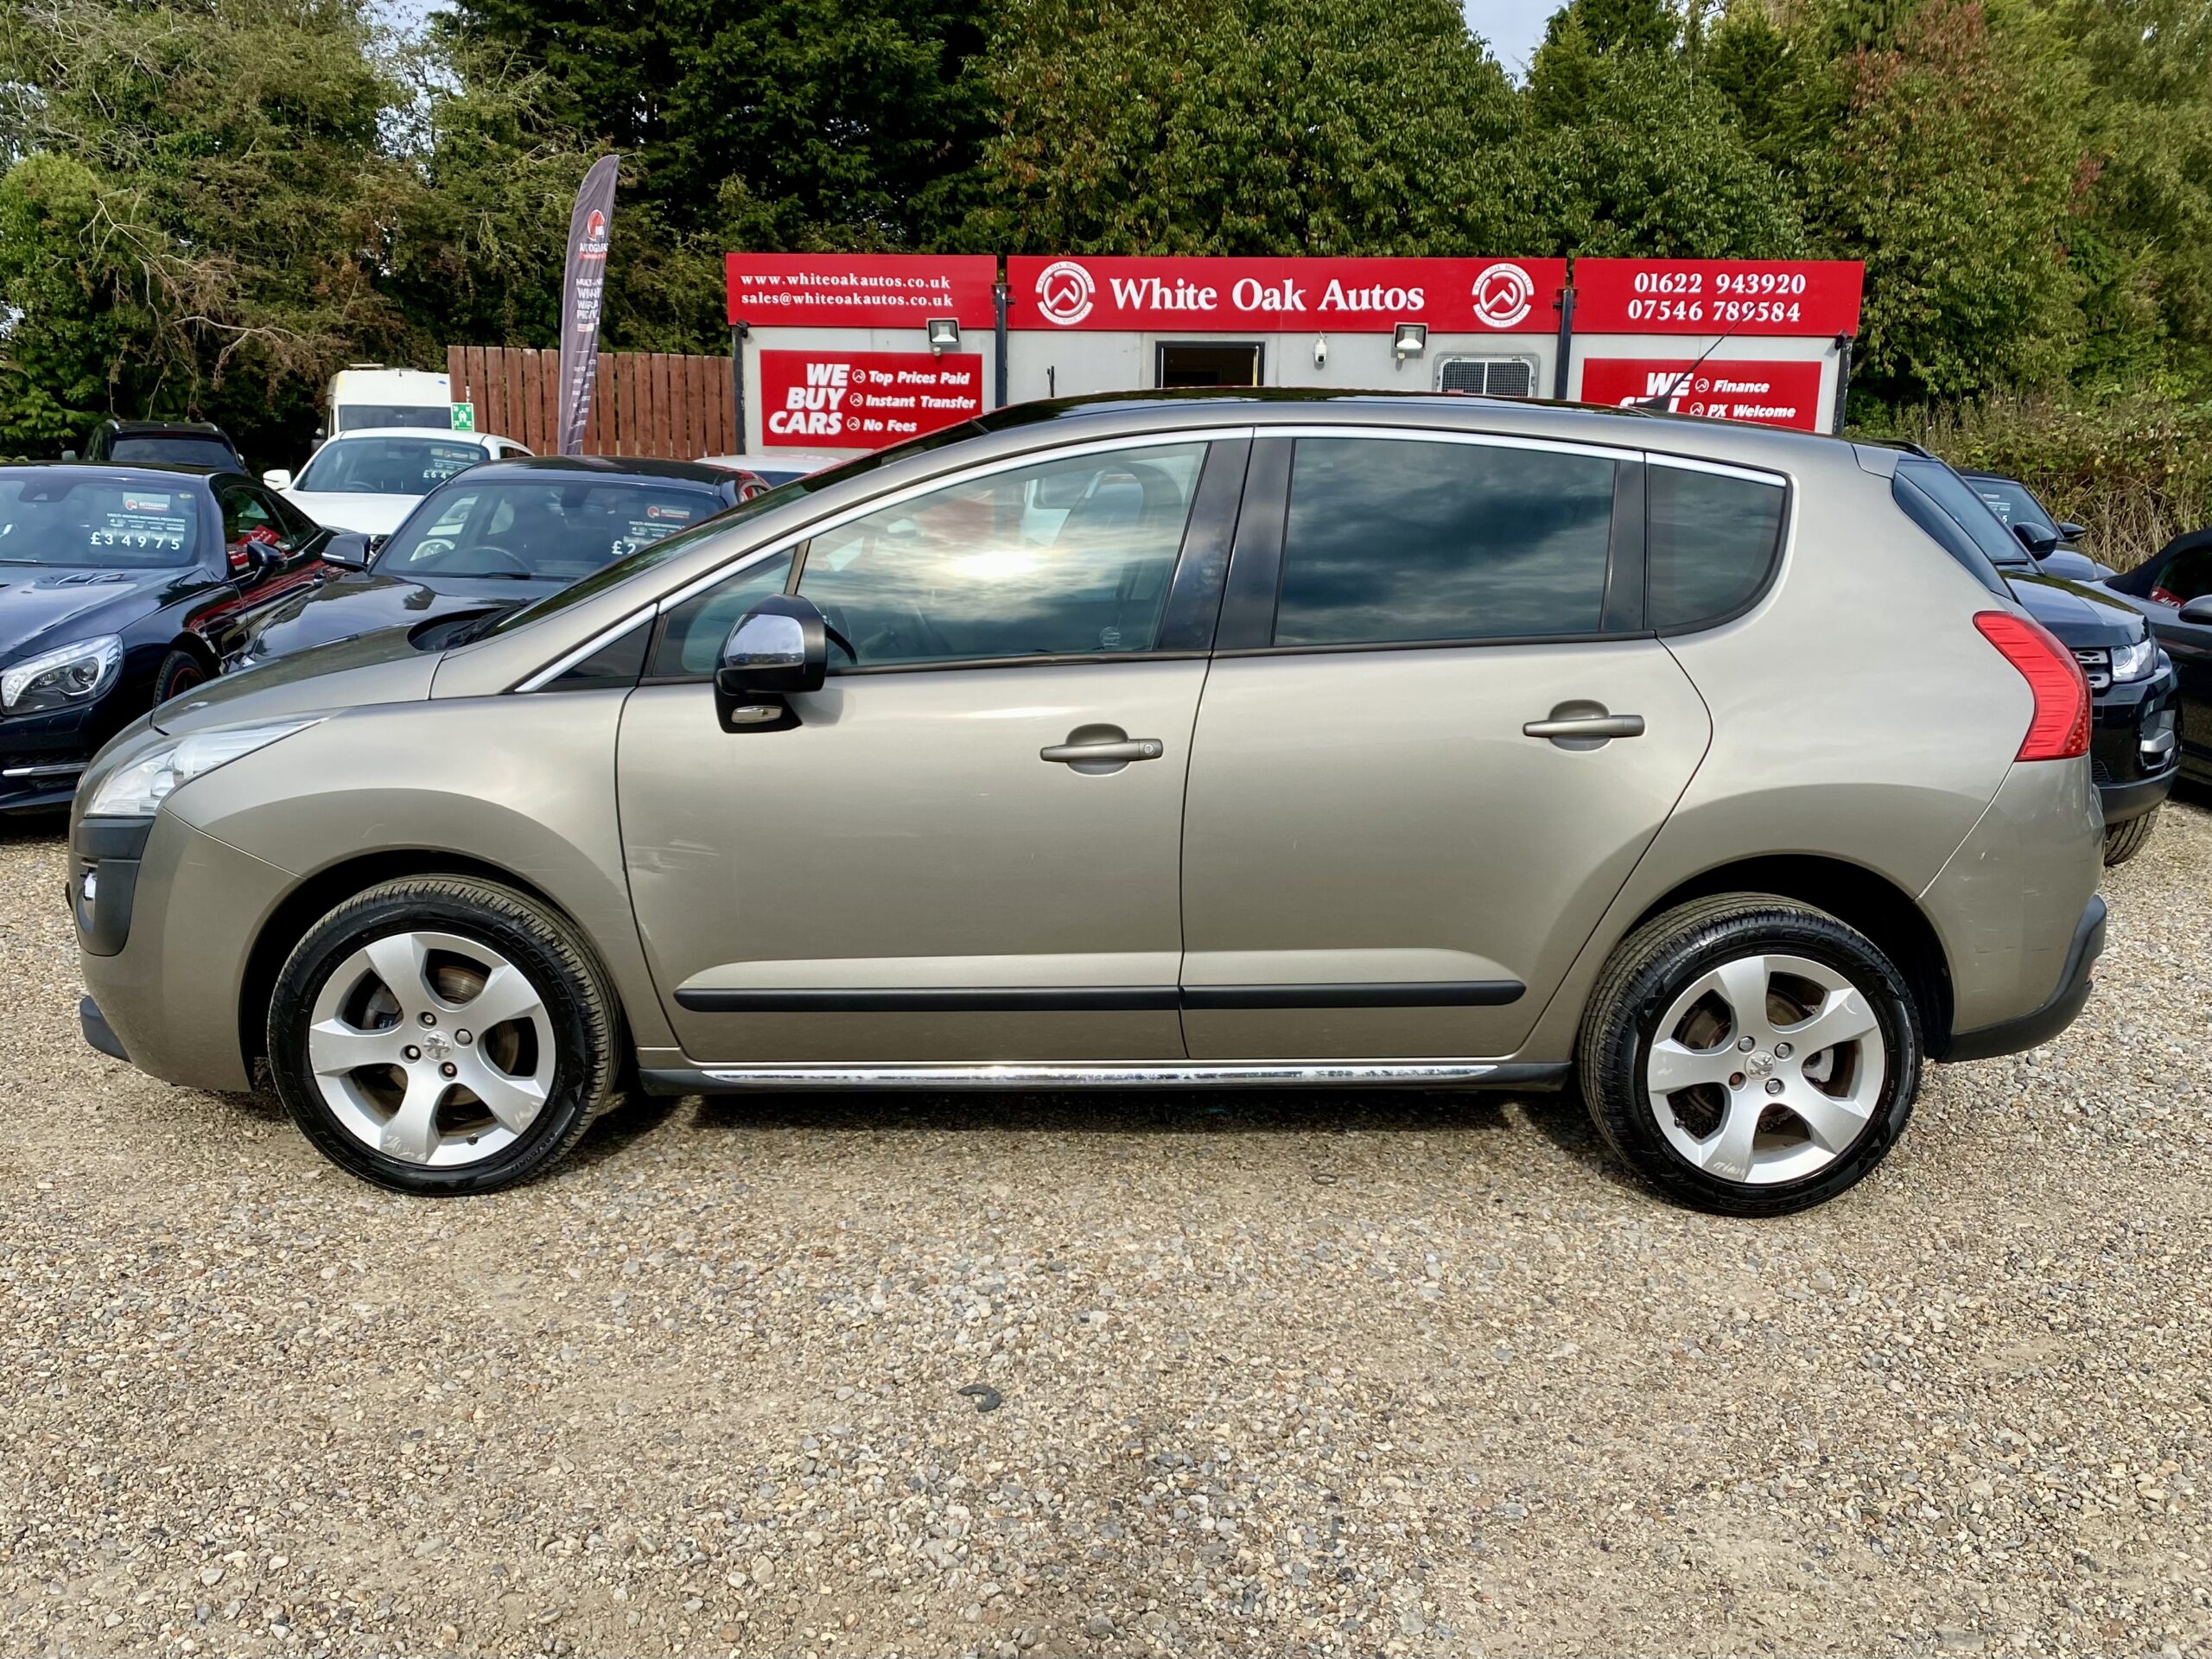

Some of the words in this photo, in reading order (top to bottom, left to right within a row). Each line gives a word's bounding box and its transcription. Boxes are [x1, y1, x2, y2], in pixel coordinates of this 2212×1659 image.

[741, 272, 951, 289] www.whiteoakautos.co.uk
[1634, 273, 1703, 294] 01622
[1715, 273, 1807, 295] 943920
[741, 292, 953, 308] sales@whiteoakautos.co.uk
[1109, 277, 1217, 312] White
[1232, 277, 1307, 312] Oak
[1317, 279, 1425, 312] Autos
[1628, 299, 1704, 321] 07546
[1713, 301, 1802, 322] 789584
[806, 363, 850, 386] WE
[869, 371, 893, 386] Top
[897, 371, 937, 385] Prices
[939, 372, 969, 385] Paid
[1646, 372, 1694, 397] WE
[1713, 379, 1770, 393] Finance
[786, 387, 847, 410] BUY
[866, 395, 915, 408] Instant
[920, 396, 976, 410] Transfer
[1707, 404, 1728, 417] PX
[1732, 404, 1796, 418] Welcome
[768, 411, 842, 435] CARS
[863, 419, 883, 431] No
[887, 419, 917, 432] Fees
